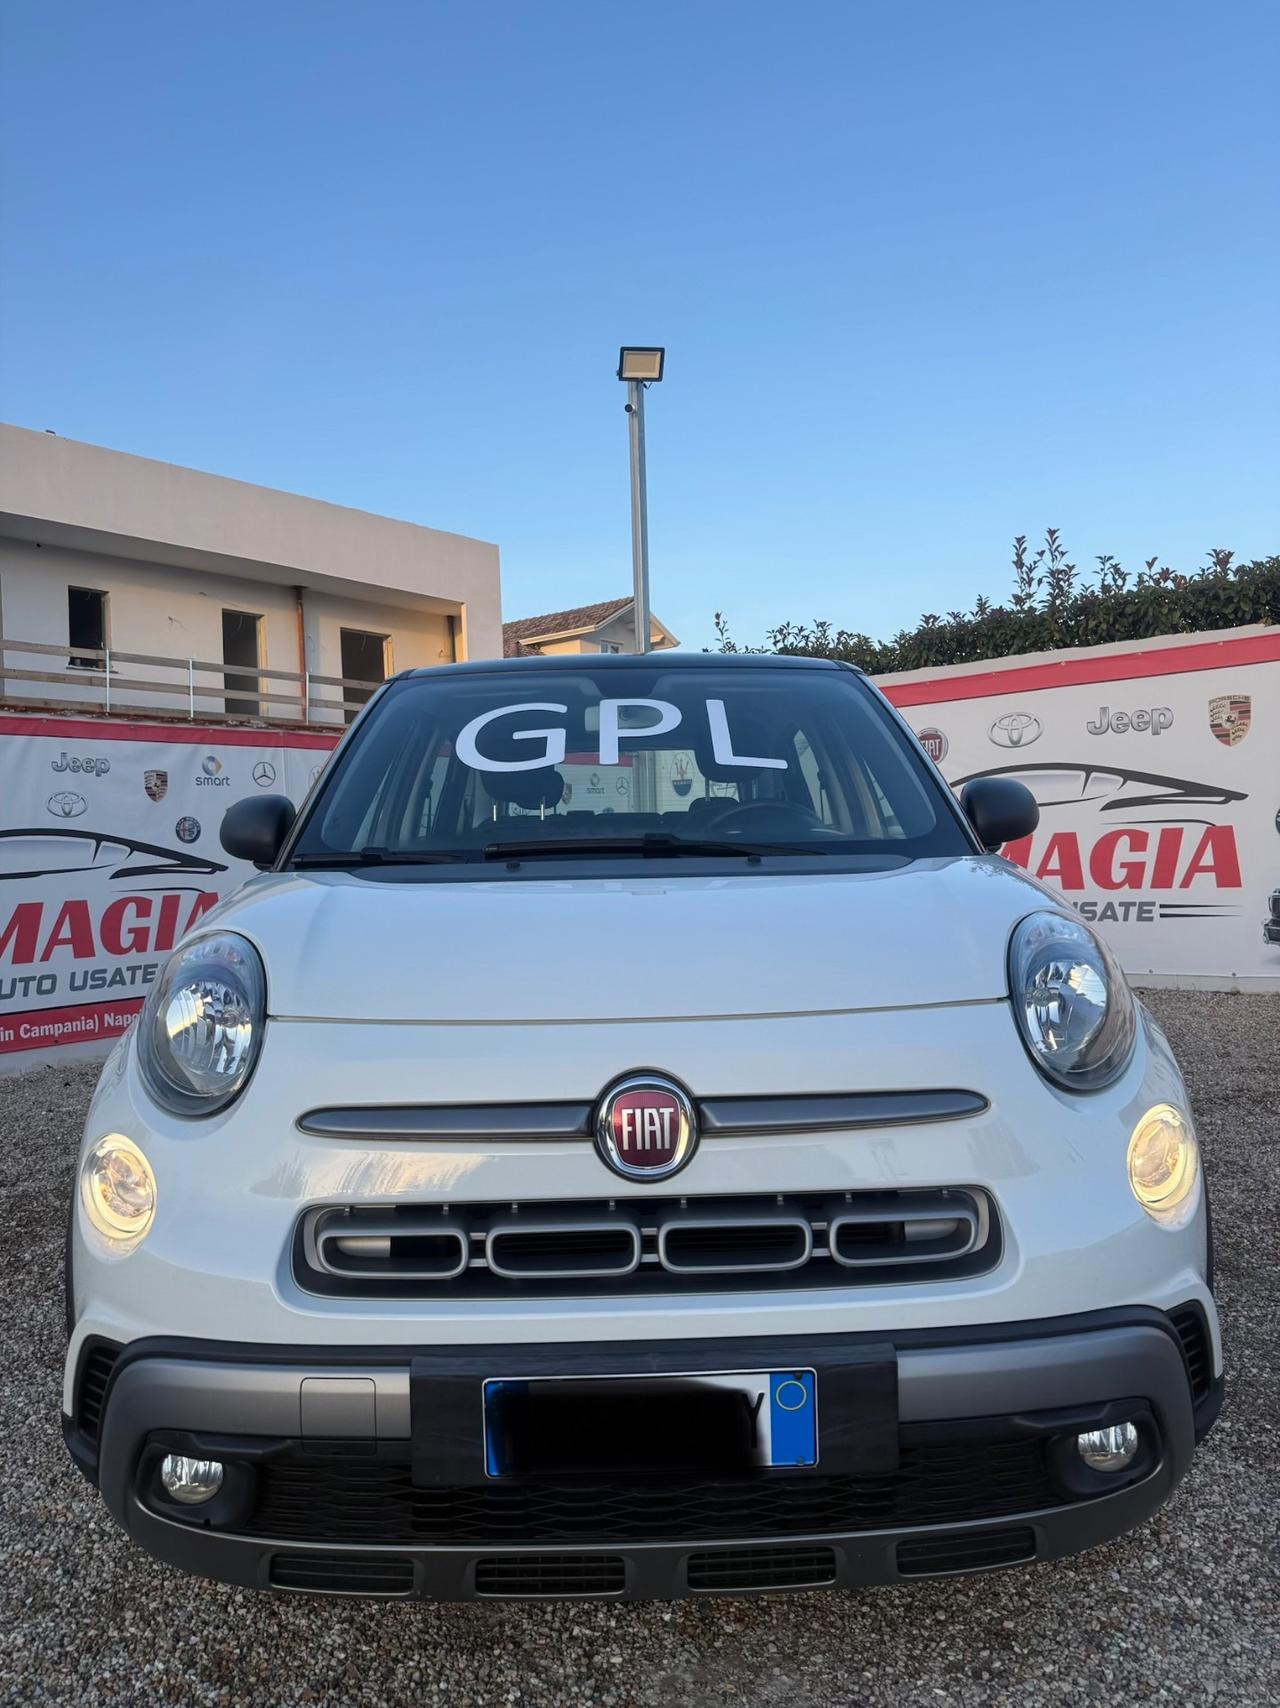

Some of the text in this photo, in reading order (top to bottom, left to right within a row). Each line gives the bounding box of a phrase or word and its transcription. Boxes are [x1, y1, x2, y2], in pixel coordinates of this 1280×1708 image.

[455, 698, 789, 773] GPL
[1086, 706, 1174, 736] Jeep
[51, 752, 111, 777] Jeep
[195, 776, 230, 786] smart
[1001, 825, 1243, 891] AGIA
[1073, 901, 1156, 922] SATE
[69, 963, 158, 992] USATE
[19, 1014, 99, 1040] Campania)
[104, 1009, 143, 1028] Napo
[621, 1107, 674, 1151] FIAT
